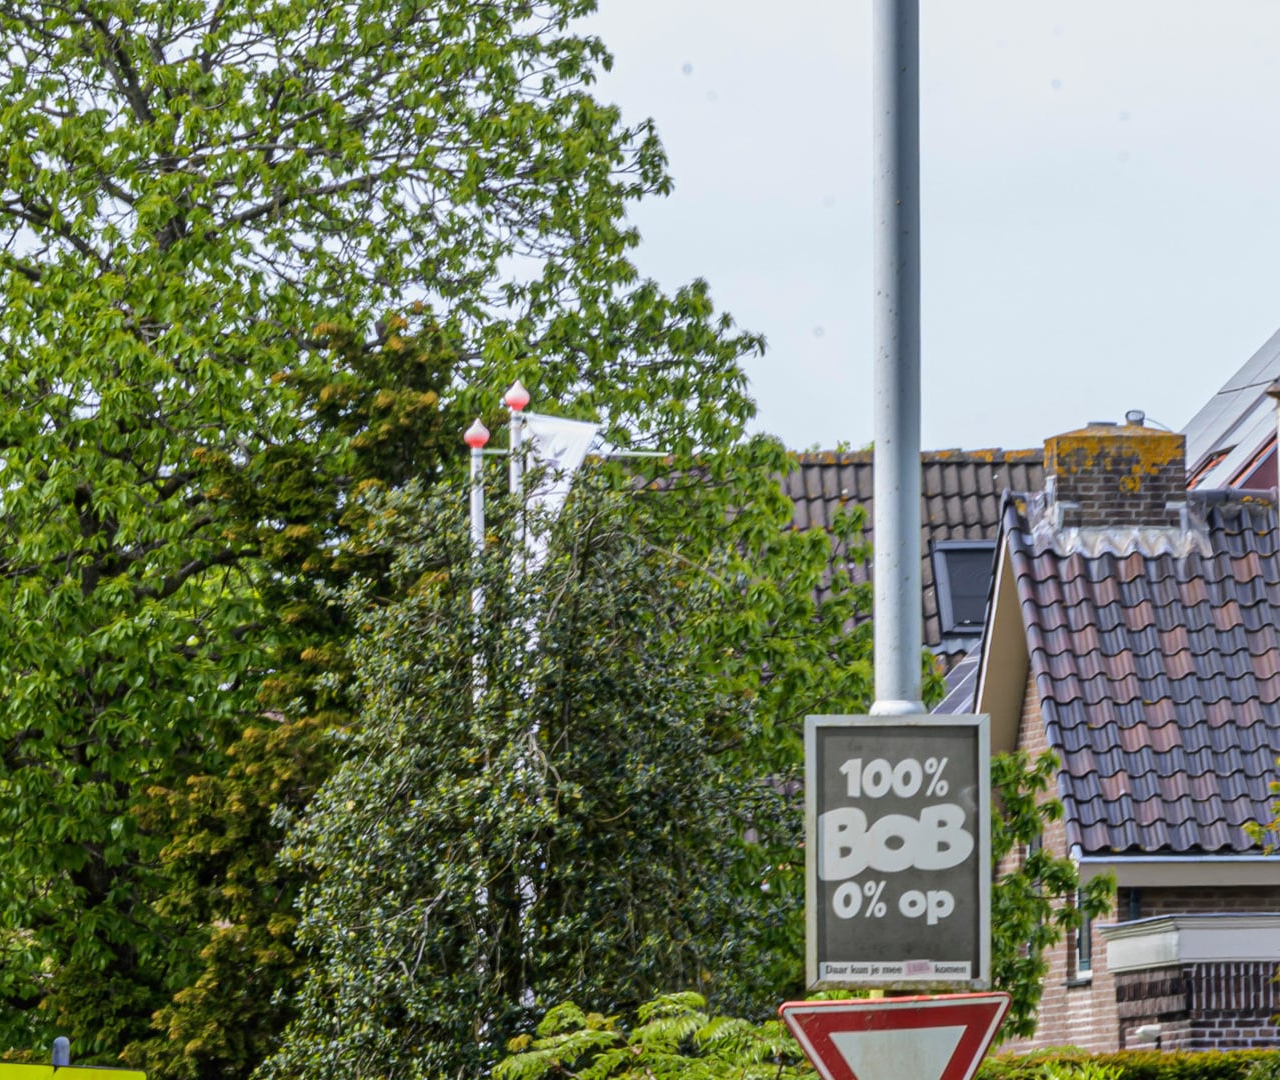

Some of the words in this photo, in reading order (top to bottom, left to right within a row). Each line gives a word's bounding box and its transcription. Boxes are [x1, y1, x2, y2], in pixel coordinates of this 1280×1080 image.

[839, 757, 949, 798] 100%
[817, 803, 975, 881] BOB
[832, 880, 887, 919] 0%
[898, 890, 955, 925] op
[825, 964, 848, 974] Daar
[850, 964, 868, 974] kun
[870, 965, 879, 976] je
[882, 966, 903, 974] mee
[934, 964, 966, 974] komen
